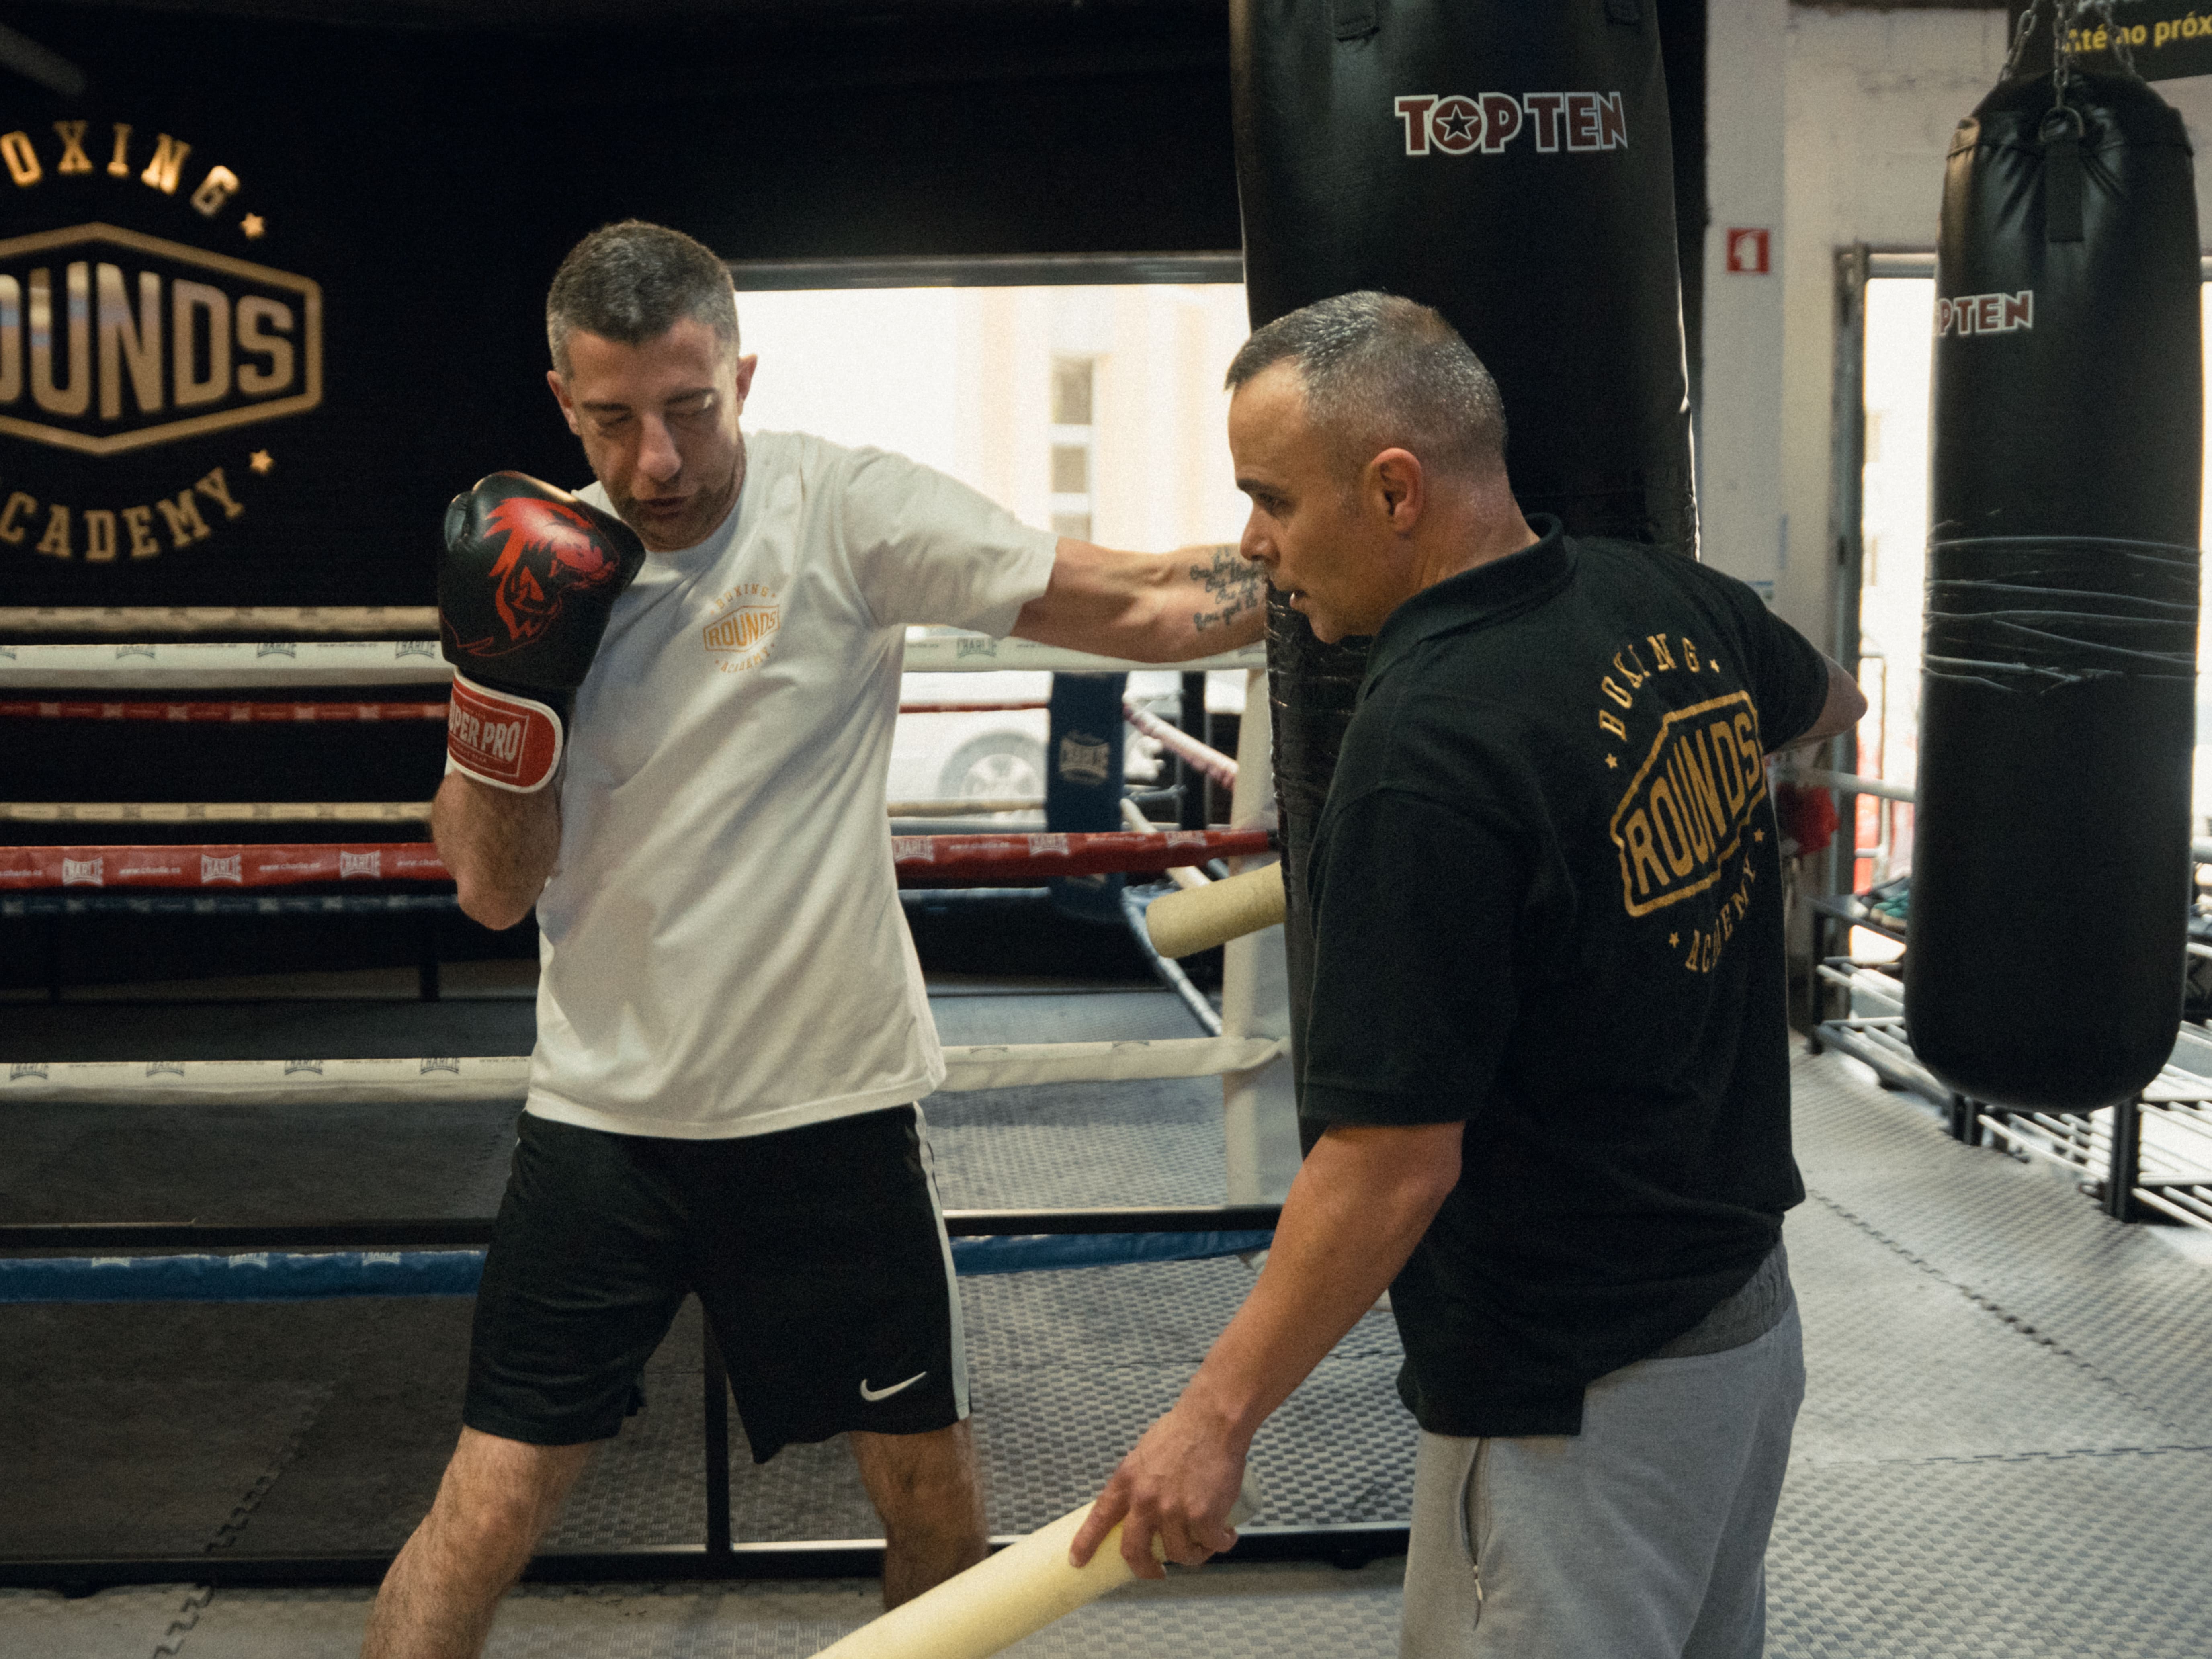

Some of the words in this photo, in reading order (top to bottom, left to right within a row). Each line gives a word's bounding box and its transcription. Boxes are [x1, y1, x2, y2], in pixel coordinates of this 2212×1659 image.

[716, 584, 769, 609] BOXING
[708, 611, 776, 647] ROUNDS
[449, 698, 480, 747] UPER
[481, 721, 521, 762] PRO
[1625, 712, 1760, 895] ROUNDS
[201, 854, 241, 881] CHARLIE
[340, 850, 381, 877] CHARLIE
